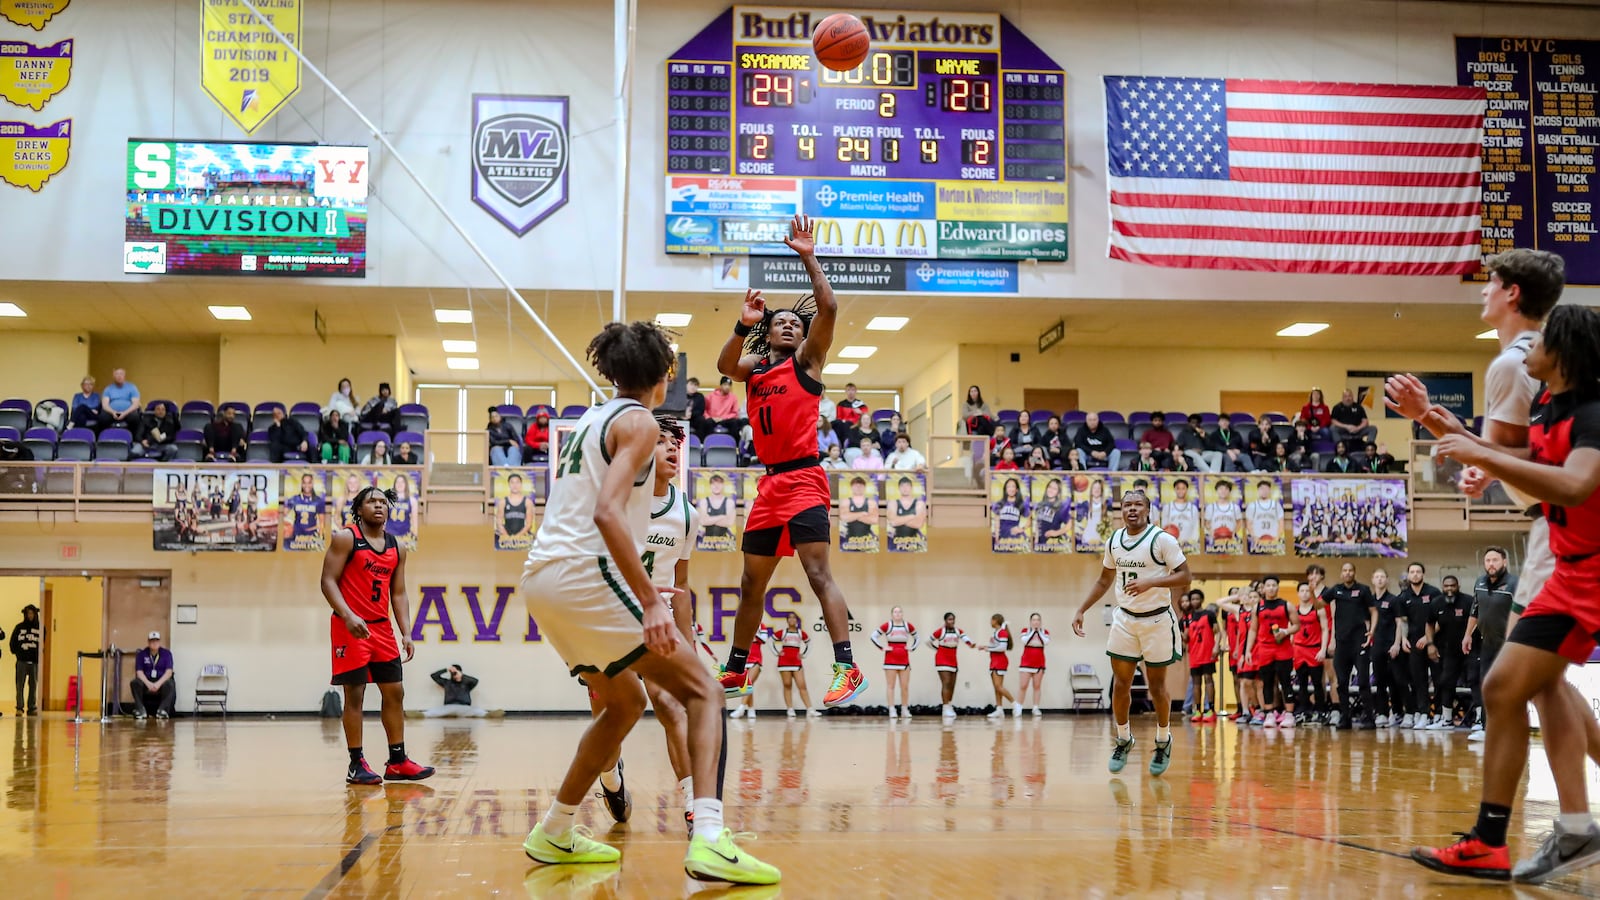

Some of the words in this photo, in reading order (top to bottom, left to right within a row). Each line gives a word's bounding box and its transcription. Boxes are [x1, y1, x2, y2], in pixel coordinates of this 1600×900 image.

[740, 12, 822, 40] Butl
[861, 15, 994, 46] Aviators
[213, 49, 277, 61] DIVISION
[282, 51, 288, 62] I
[741, 53, 811, 70] SYCAMORE
[1478, 52, 1506, 62] BOYS
[1551, 53, 1581, 64] GIRLS
[15, 60, 54, 69] DANNY
[935, 59, 981, 76] WAYNE
[1466, 61, 1518, 74] FOOTBALL
[1549, 64, 1585, 76] TENNIS
[20, 71, 49, 80] NEFF
[229, 68, 270, 82] 2019
[752, 74, 793, 106] 24
[1536, 81, 1599, 93] VOLLEYBALL
[950, 79, 990, 111] 21
[836, 97, 876, 111] PERIOD
[879, 92, 896, 119] 2
[1489, 99, 1530, 111] COUNTRY
[1533, 115, 1562, 126] CROSS
[1563, 116, 1600, 127] COUNTRY
[1, 126, 25, 134] 2019
[740, 123, 775, 136] FOULS
[792, 124, 823, 137] T.O.L.
[833, 126, 874, 138] PLAYER
[877, 126, 905, 139] FOUL
[914, 127, 946, 140] T.O.L.
[961, 128, 995, 141] FOULS
[17, 141, 49, 149] DREW
[483, 131, 558, 159] MVL
[1482, 136, 1524, 148] ESTLING
[1537, 133, 1600, 146] BASKETBALL
[752, 135, 768, 159] 2
[798, 137, 815, 160] 4
[838, 136, 870, 162] 24
[920, 140, 938, 163] 4
[973, 140, 989, 165] 2
[14, 152, 51, 160] SACKS
[1546, 153, 1594, 165] SWIMMING
[134, 142, 171, 189] S
[739, 163, 775, 175] SCORE
[850, 164, 887, 177] MATCH
[487, 167, 553, 177] ATHLETICS
[961, 167, 996, 180] SCORE
[1480, 171, 1516, 182] TENNIS
[1555, 173, 1588, 184] TRACK
[840, 190, 884, 203] Premier
[886, 191, 925, 204] Health
[939, 187, 965, 204] Morton
[1015, 189, 1043, 205] Funeral
[1044, 189, 1065, 206] Home
[1483, 191, 1511, 202] GOLF
[840, 203, 864, 211] Miami
[866, 204, 887, 213] Valley
[889, 205, 920, 214] Hospital
[1552, 202, 1592, 213] SOCCER
[158, 208, 318, 233] DIVISION
[325, 209, 338, 236] I
[724, 222, 750, 232] WE
[756, 222, 790, 233] ARE
[1547, 221, 1599, 233] SOFTBALL
[1480, 227, 1515, 238] TRACK
[815, 247, 844, 255] ANDALIA
[852, 247, 886, 256] VANDALIA
[895, 247, 928, 256] VANDALIA
[940, 246, 966, 257] Serving
[967, 247, 1000, 256] Individual
[1002, 248, 1031, 256] Investors
[1032, 248, 1050, 257] Since
[763, 261, 829, 272] PARTNEG
[833, 263, 846, 272] TO
[849, 263, 881, 273] BUILD
[884, 264, 892, 273] A
[937, 267, 974, 278] Premier
[977, 268, 1010, 279] Health
[765, 273, 813, 282] HEALTHI
[827, 274, 891, 284] COMMUNITY
[978, 279, 1005, 287] Hospital
[750, 380, 788, 402] Wayne
[1440, 393, 1465, 402] Health
[759, 405, 773, 436] 11
[300, 511, 309, 525] 2
[646, 533, 676, 547] ators
[371, 580, 383, 602] 5
[814, 622, 862, 633] adas
